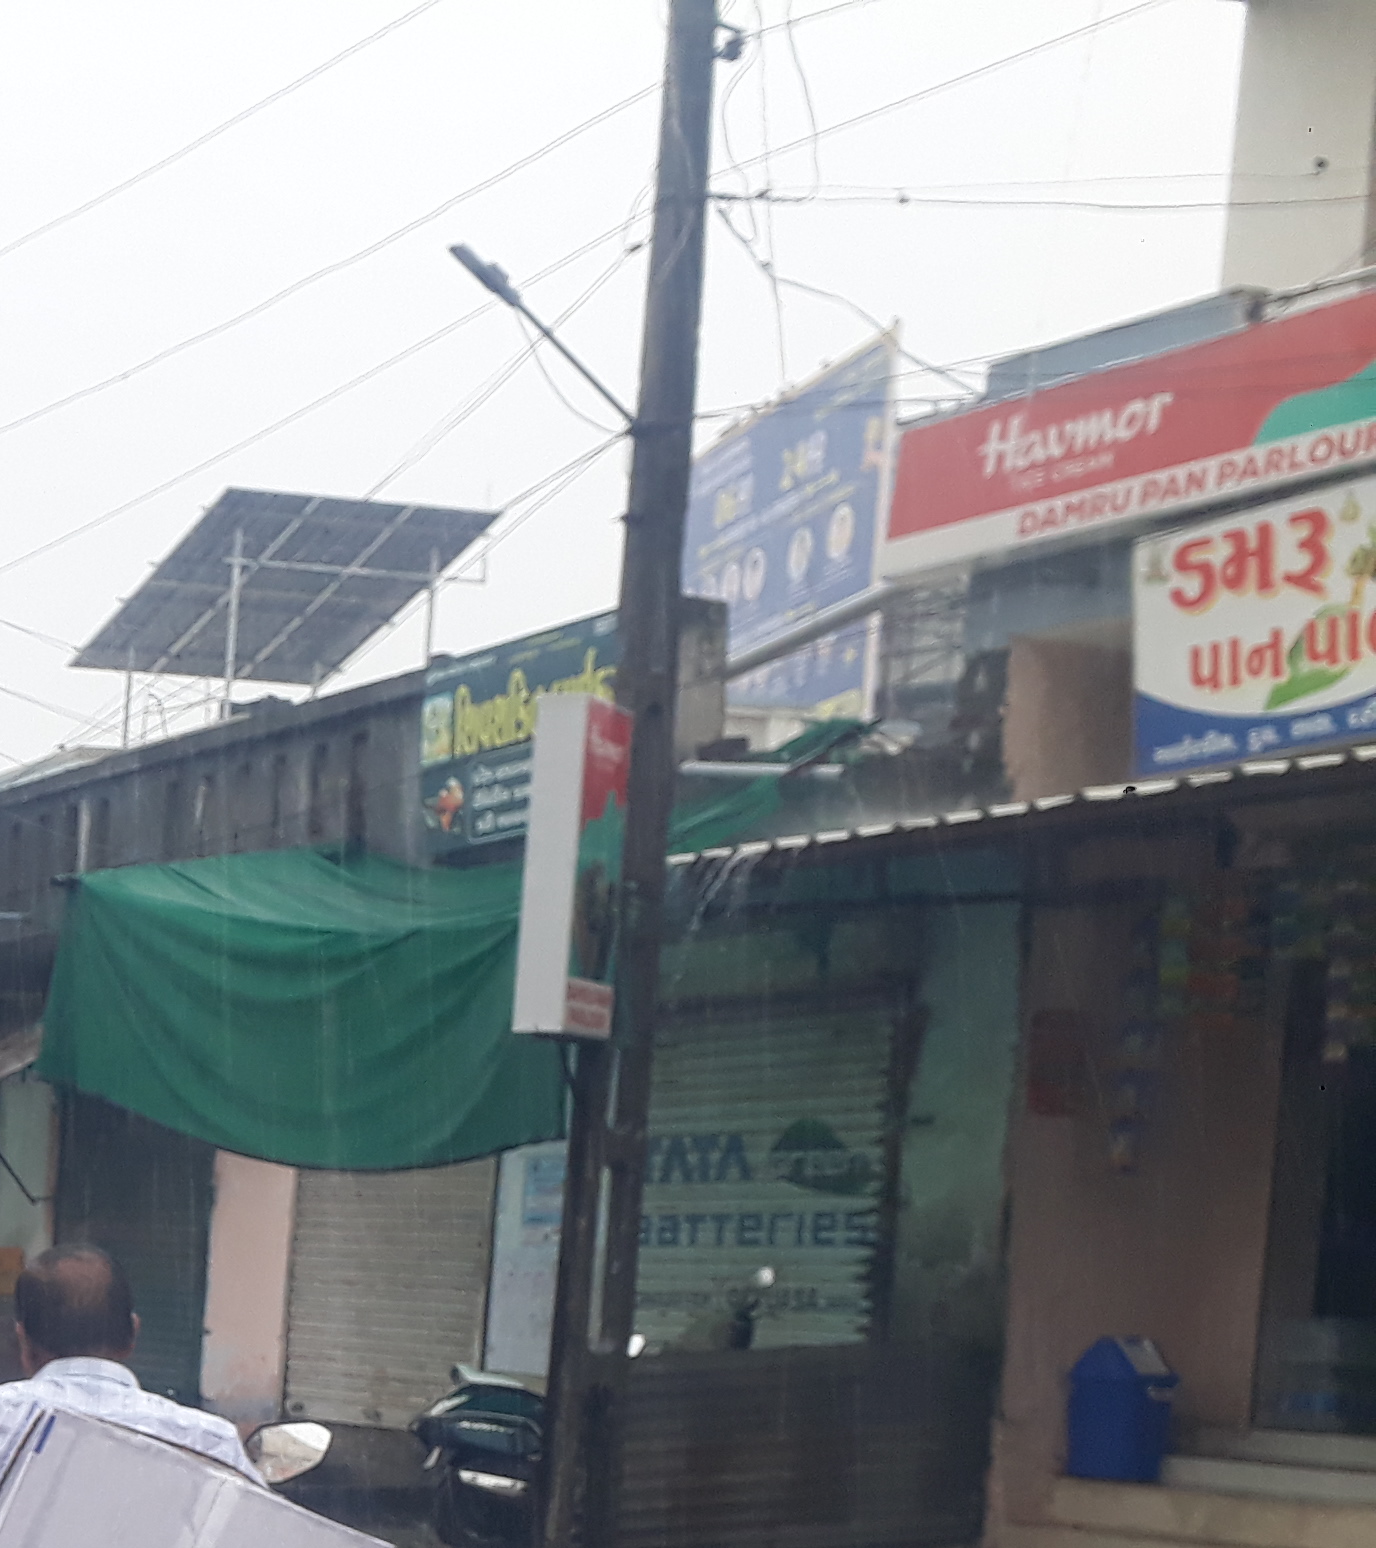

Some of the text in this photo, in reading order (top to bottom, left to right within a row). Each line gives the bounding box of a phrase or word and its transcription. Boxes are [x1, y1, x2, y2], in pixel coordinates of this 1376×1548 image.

[979, 392, 1174, 479] Havmor
[1017, 486, 1132, 539] DAMRU
[1141, 468, 1209, 511] PAN
[1189, 626, 1284, 692] પાન
